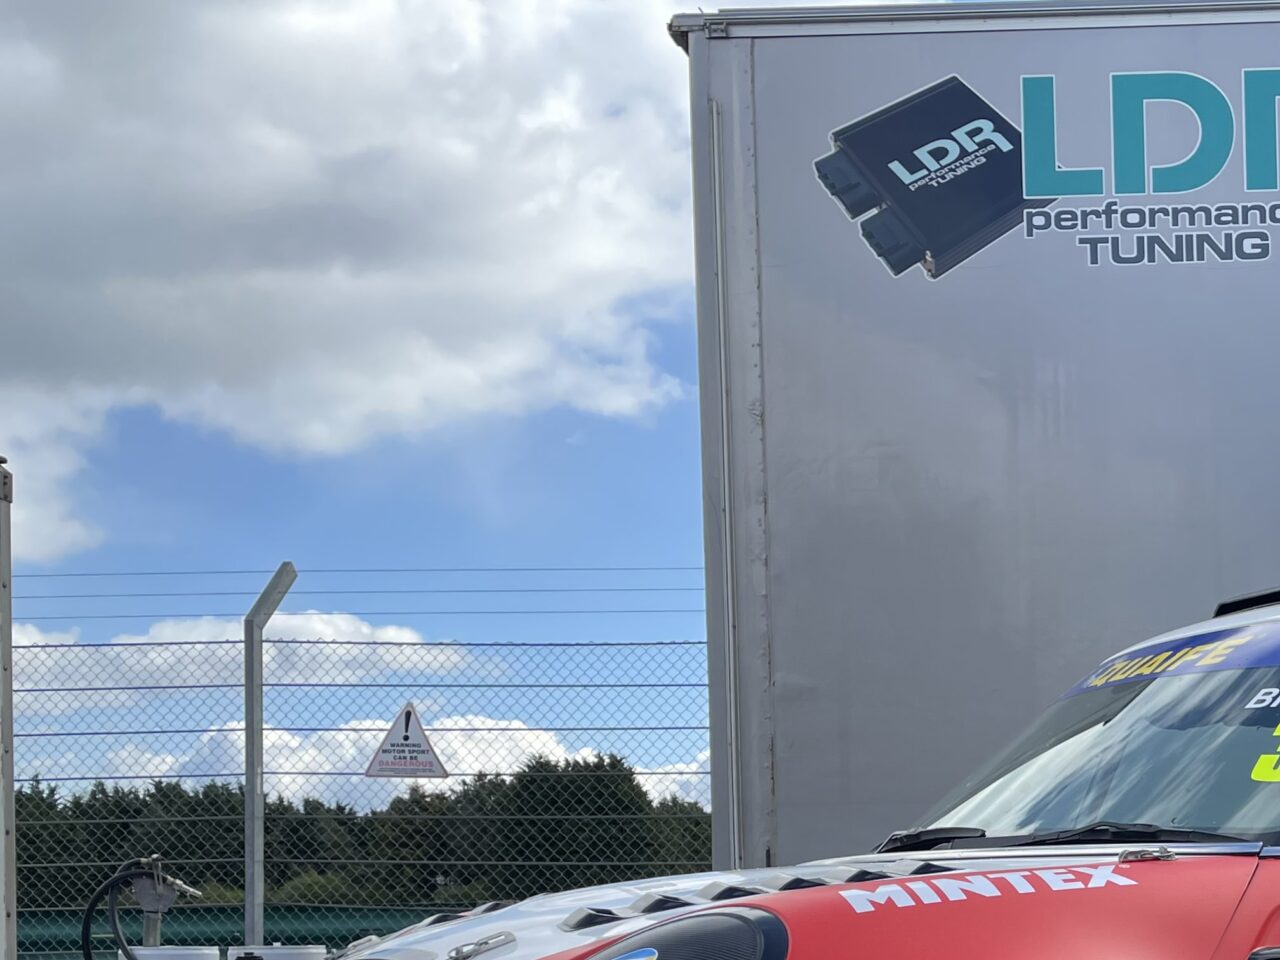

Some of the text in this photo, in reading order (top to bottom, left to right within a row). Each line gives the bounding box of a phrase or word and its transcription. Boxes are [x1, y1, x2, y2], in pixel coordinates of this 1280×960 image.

[888, 119, 1013, 184] LDR
[908, 144, 996, 191] performance
[928, 156, 986, 187] TUNING
[1076, 231, 1270, 266] TUNING
[378, 760, 434, 768] DANGEROUS
[838, 864, 1139, 913] MINTEX
